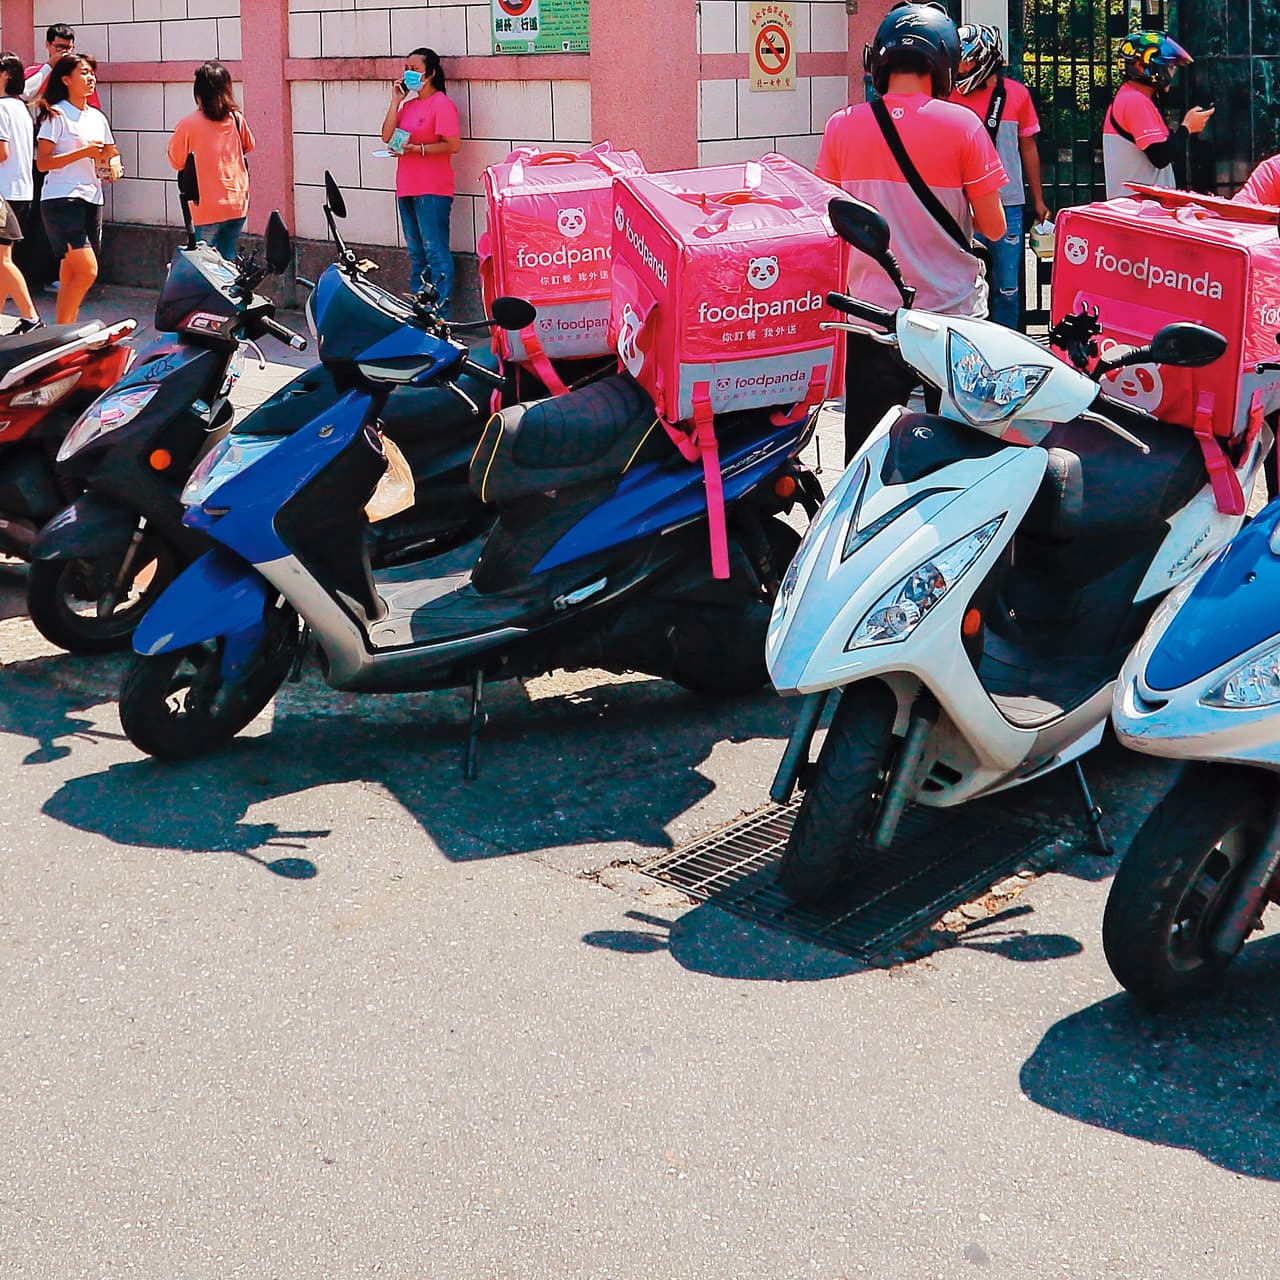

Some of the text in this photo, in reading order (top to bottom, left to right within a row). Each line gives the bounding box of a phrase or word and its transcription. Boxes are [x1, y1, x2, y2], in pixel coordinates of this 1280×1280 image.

[516, 245, 612, 269] foodpan
[624, 217, 669, 289] foodpanda
[1094, 245, 1223, 300] foodpanda
[697, 290, 824, 324] foodpanda
[557, 316, 609, 331] foodpan
[734, 370, 806, 389] foodpanda
